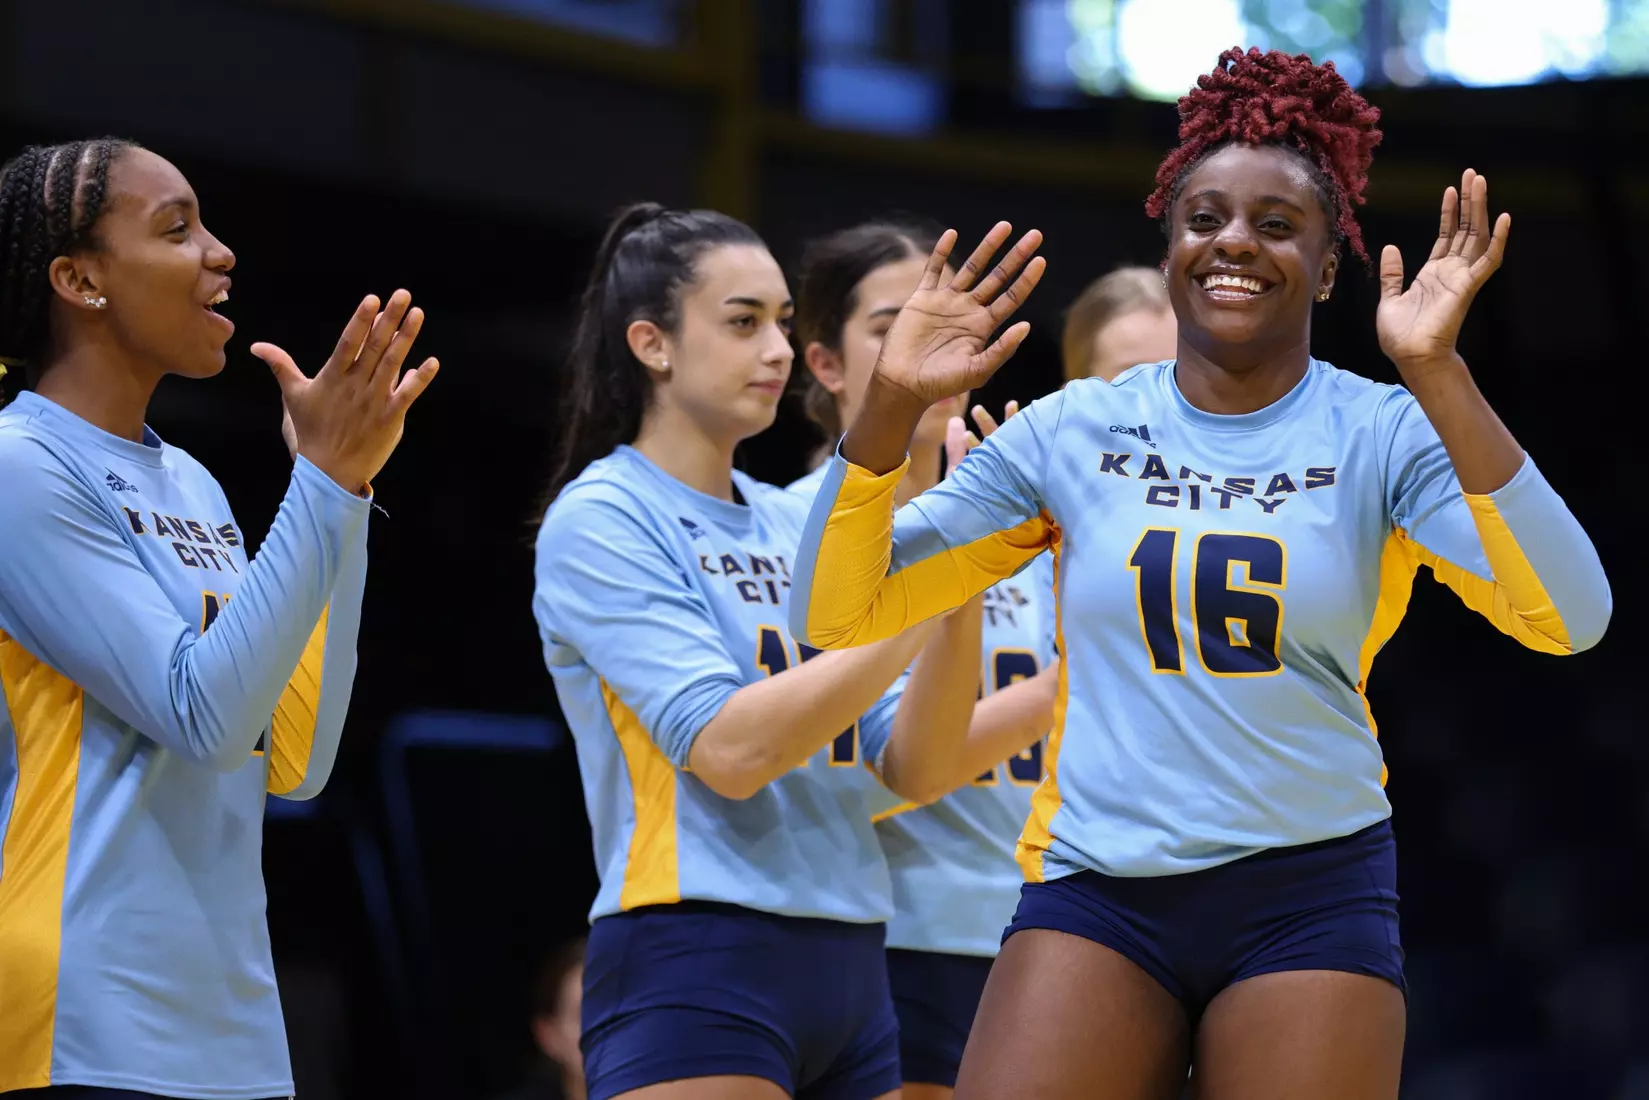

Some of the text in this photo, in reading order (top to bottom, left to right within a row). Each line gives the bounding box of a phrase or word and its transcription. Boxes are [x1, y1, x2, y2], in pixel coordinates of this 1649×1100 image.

[1099, 452, 1337, 497] KANSAS
[1145, 484, 1287, 514] CITY
[122, 506, 239, 548] KANSAS
[172, 541, 239, 574] CITY
[1125, 525, 1288, 678] 16
